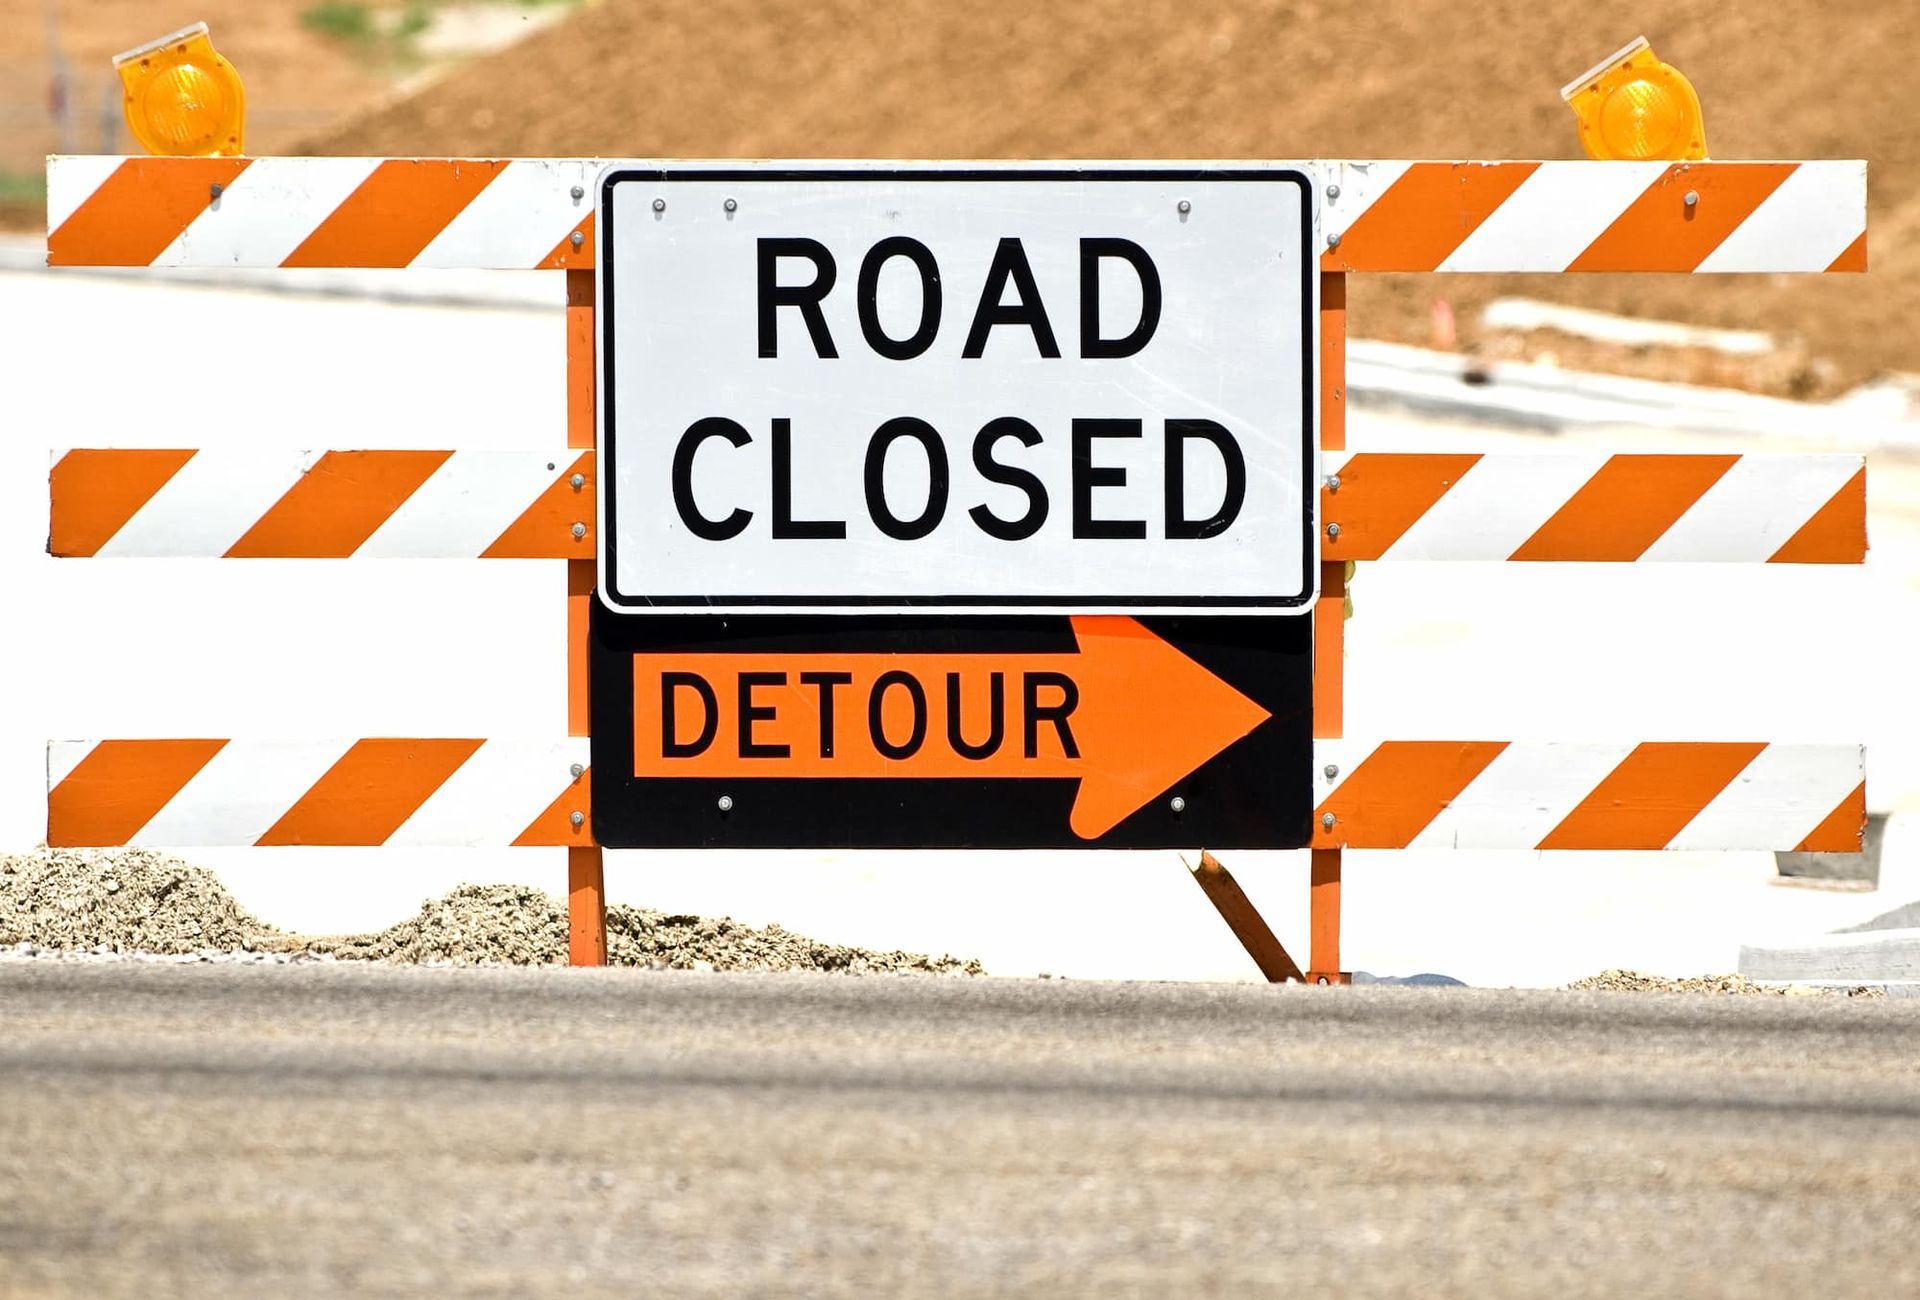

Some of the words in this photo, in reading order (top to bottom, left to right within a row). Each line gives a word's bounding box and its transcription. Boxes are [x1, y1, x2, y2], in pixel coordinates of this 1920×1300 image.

[757, 237, 1162, 360] ROAD
[672, 416, 1247, 542] CLOSED
[660, 670, 1081, 761] DETOUR
